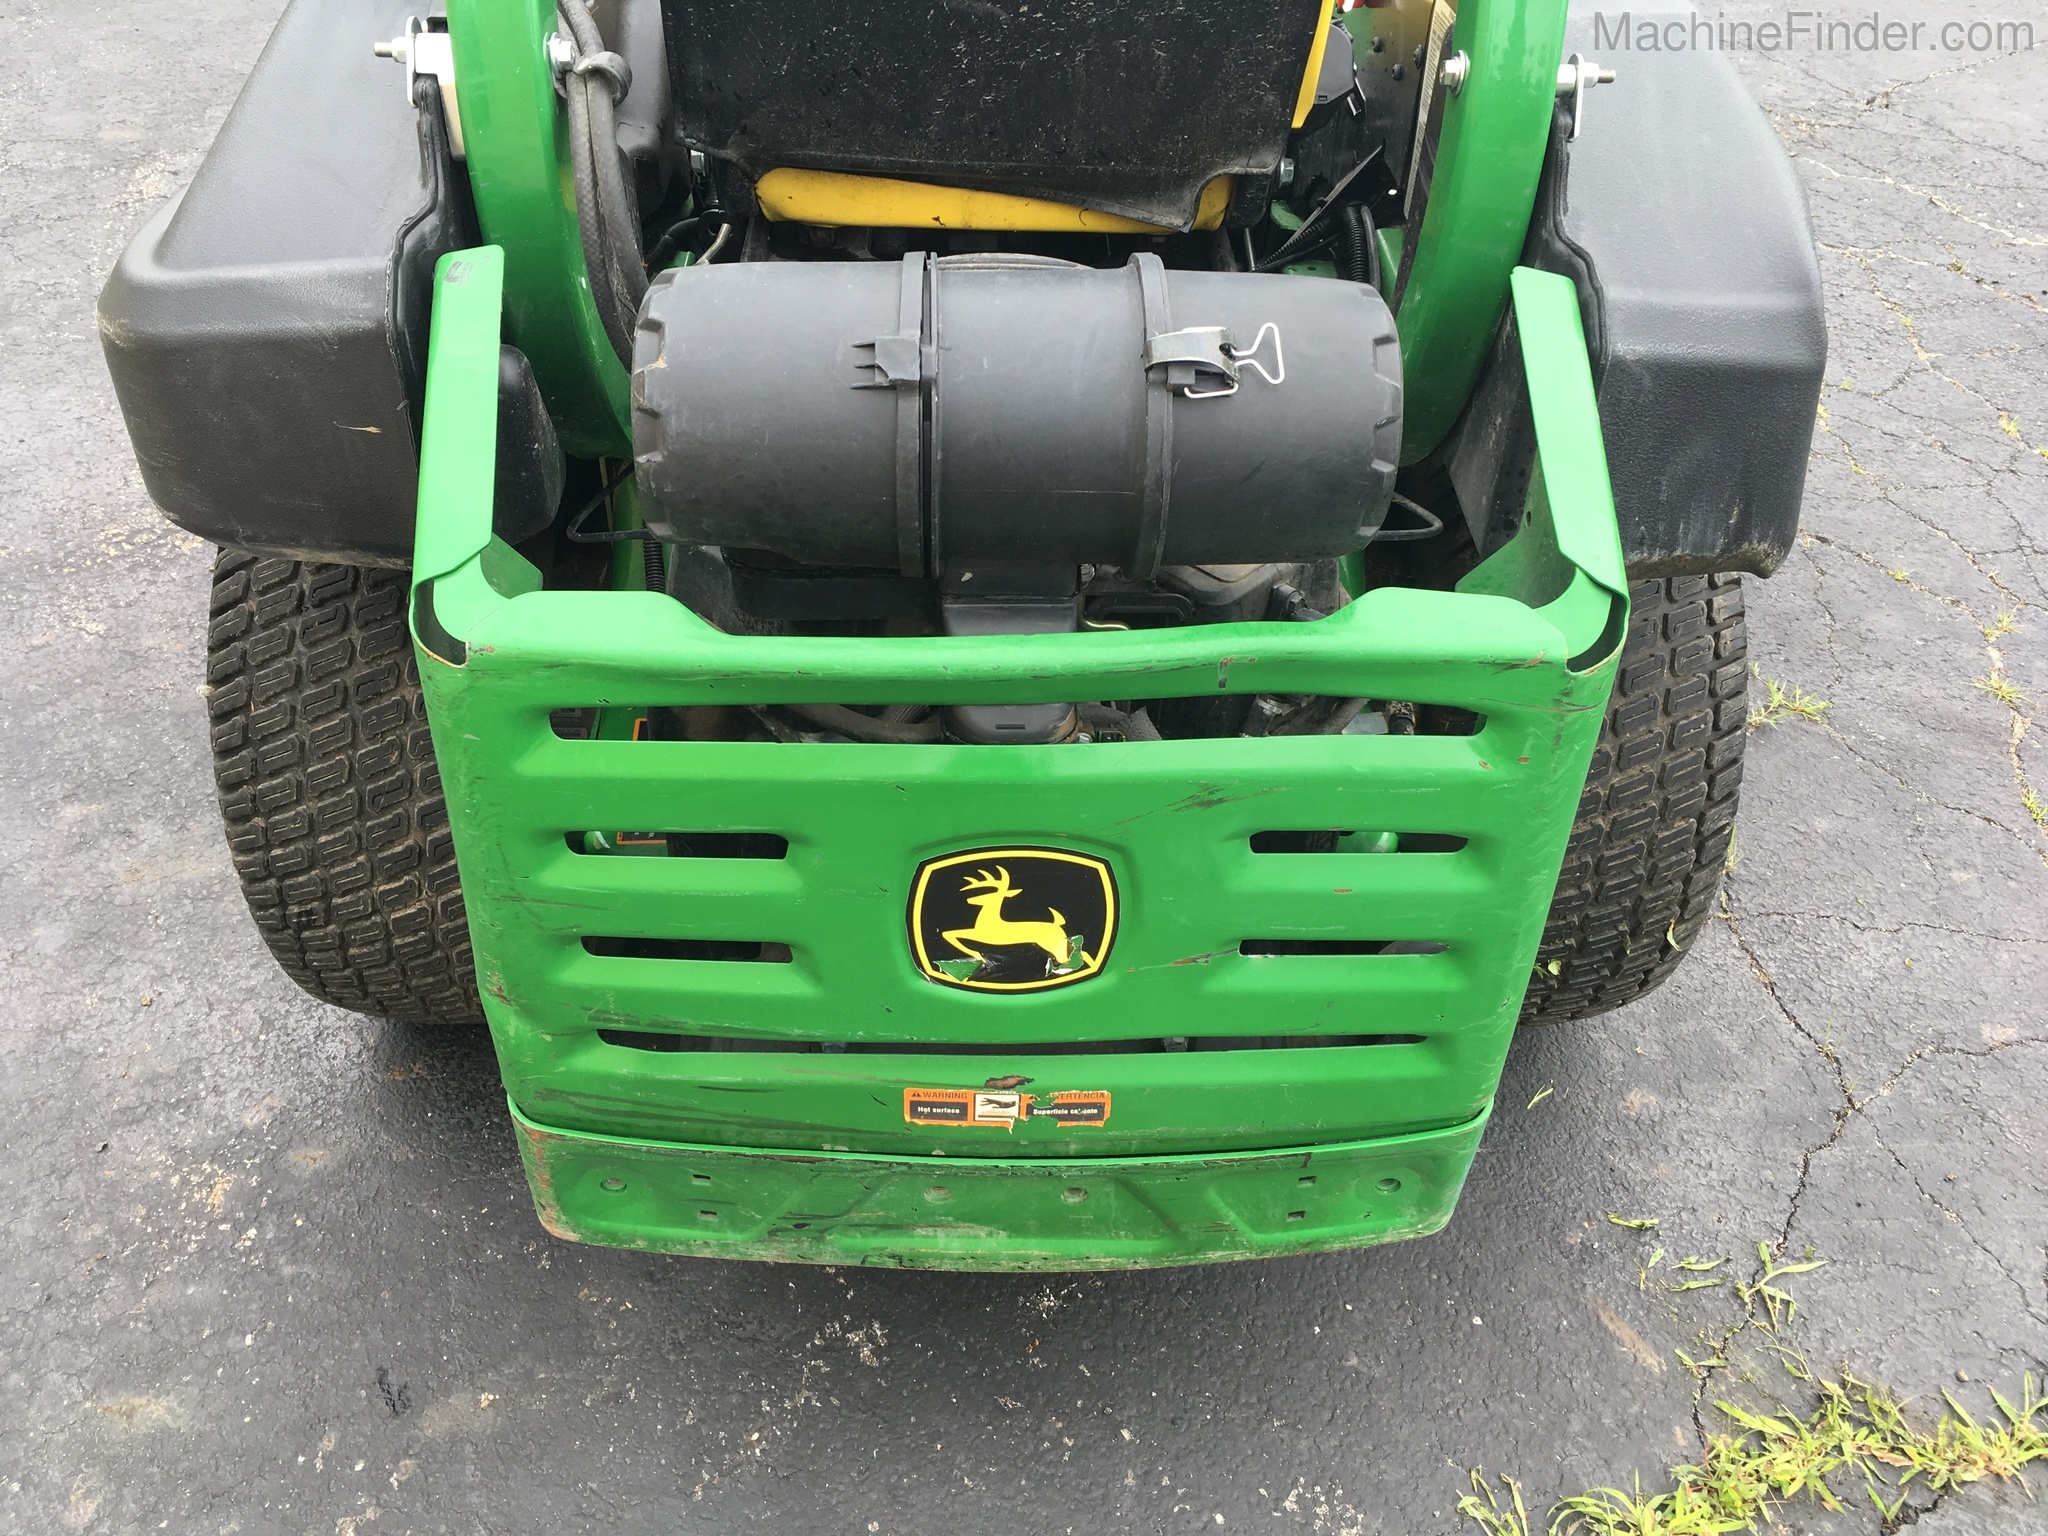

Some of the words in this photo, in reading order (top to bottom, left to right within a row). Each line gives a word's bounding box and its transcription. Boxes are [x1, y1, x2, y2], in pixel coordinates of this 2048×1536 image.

[923, 1091, 967, 1099] WARNING
[917, 1106, 931, 1114] Hot
[1032, 1108, 1069, 1116] Superficie
